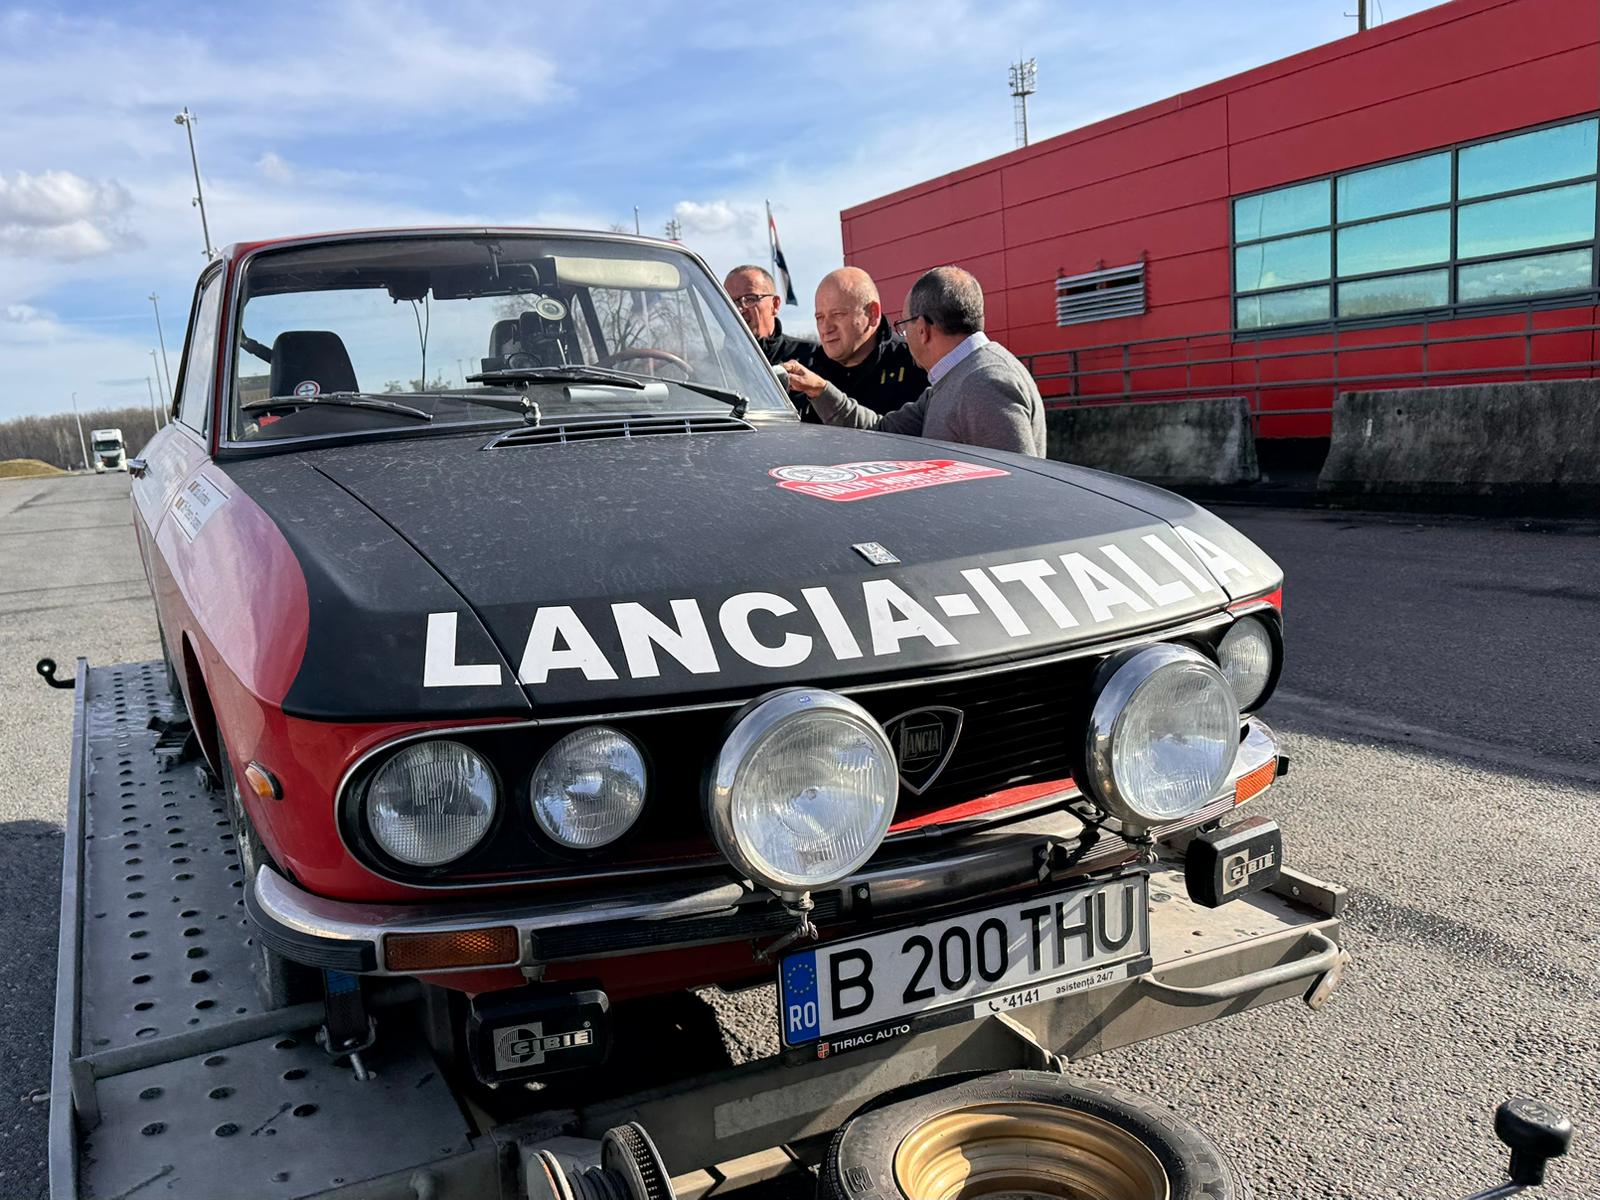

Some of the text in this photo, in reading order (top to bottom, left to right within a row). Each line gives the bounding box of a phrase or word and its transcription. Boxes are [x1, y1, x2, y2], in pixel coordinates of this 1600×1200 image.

[423, 526, 1253, 688] LANCIA-ITALIA
[903, 730, 939, 759] LANCIA
[829, 886, 1135, 1020] B 200 THU
[1096, 970, 1115, 985] 24/7
[788, 1001, 817, 1033] RO
[832, 1024, 911, 1053] TIRIAC AUTO
